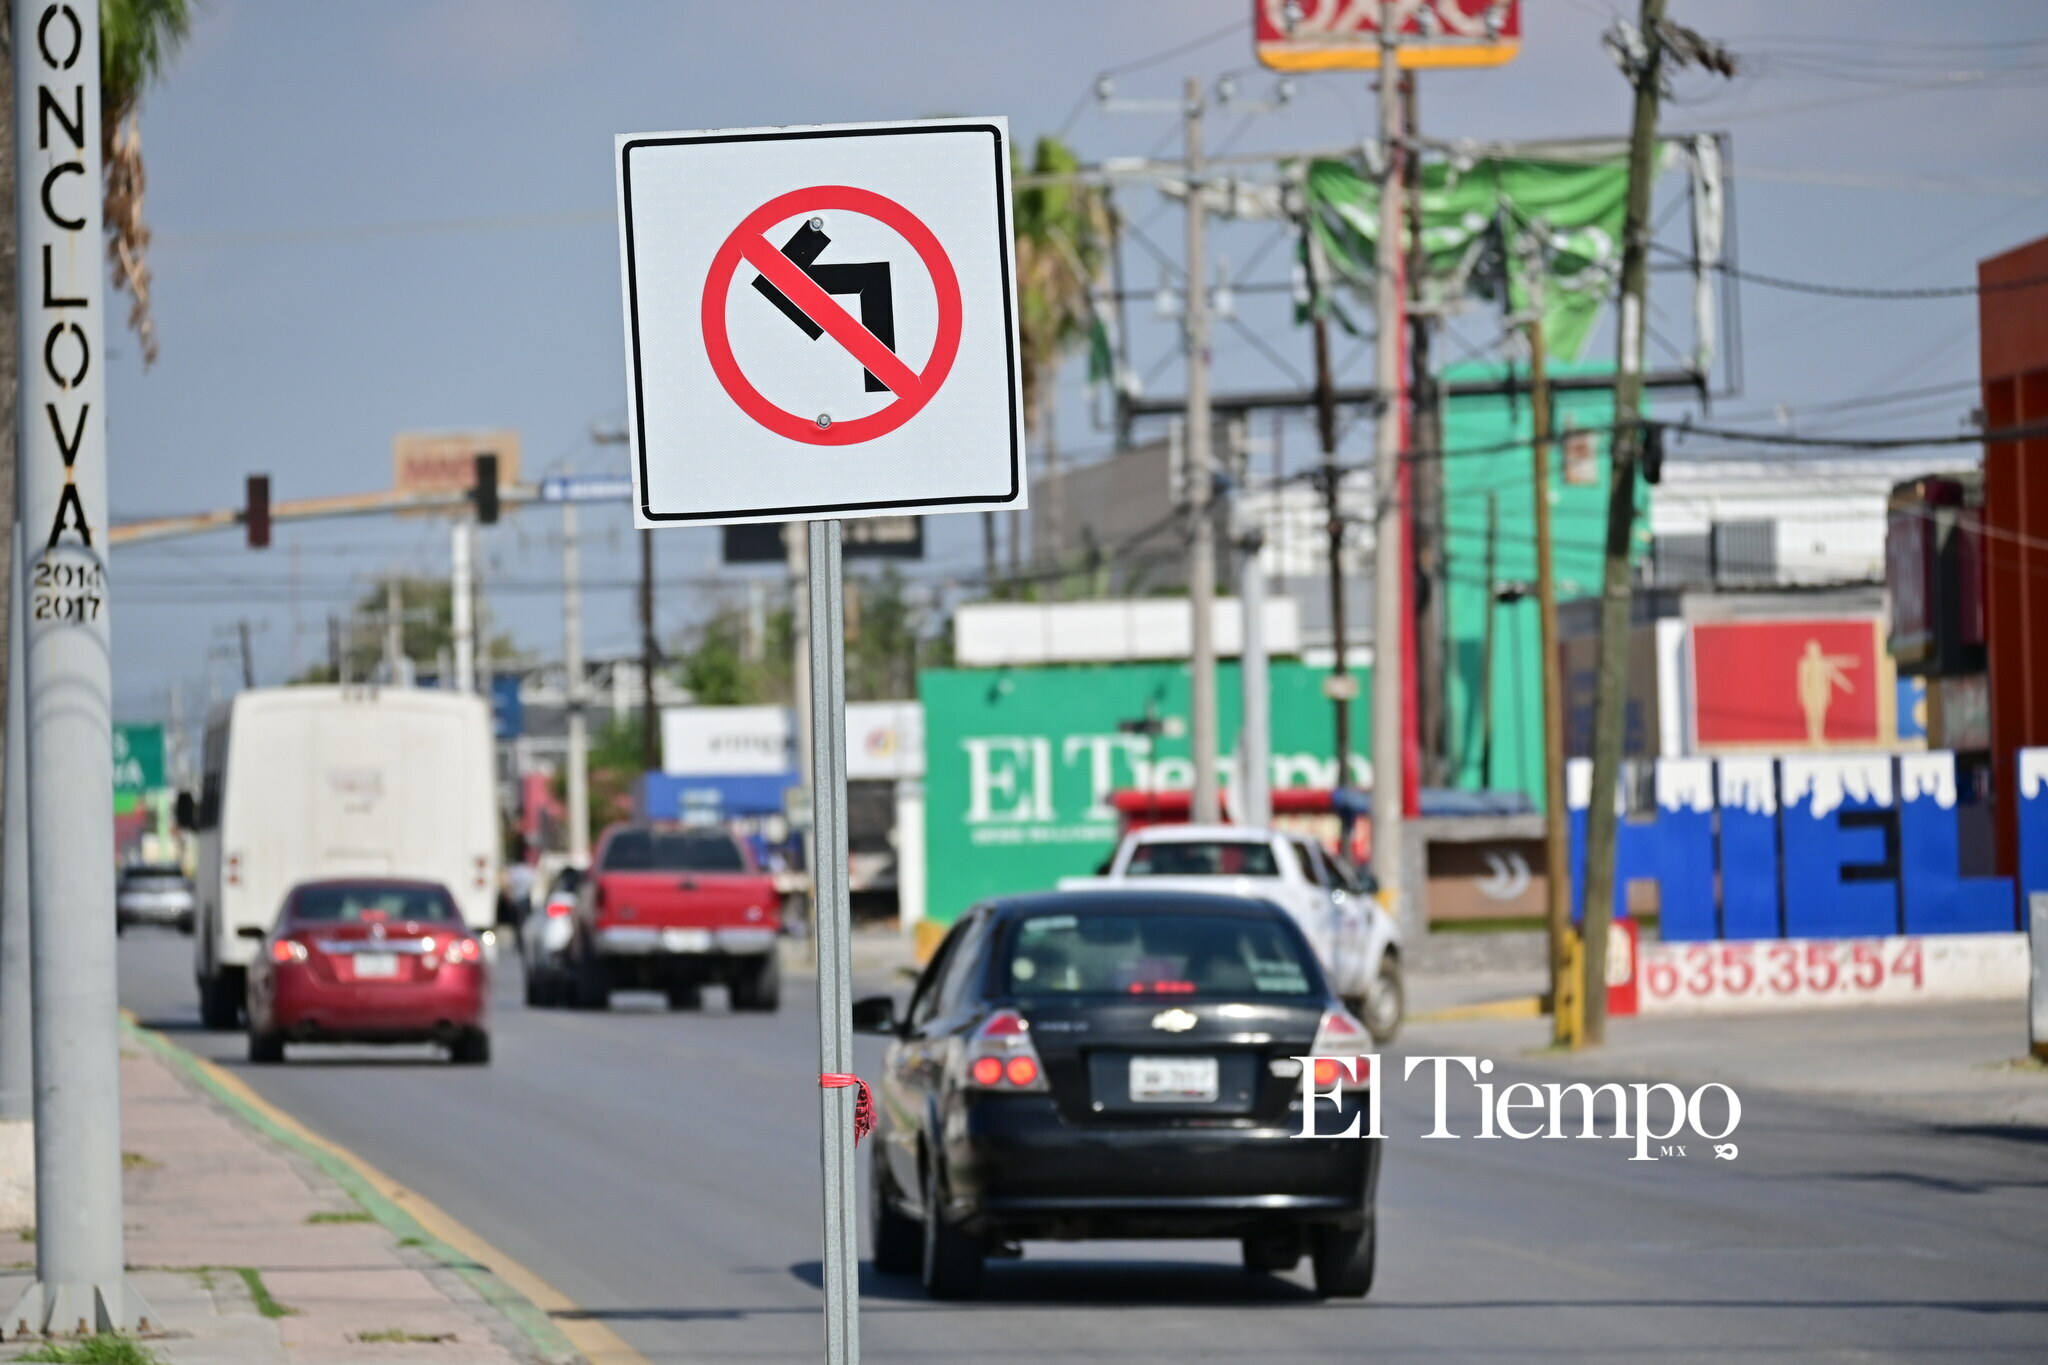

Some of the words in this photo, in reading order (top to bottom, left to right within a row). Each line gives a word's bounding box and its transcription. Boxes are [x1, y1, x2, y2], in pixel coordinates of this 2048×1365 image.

[35, 595, 101, 622] 2017
[964, 736, 1055, 822] El
[1567, 747, 2048, 942] HIEL
